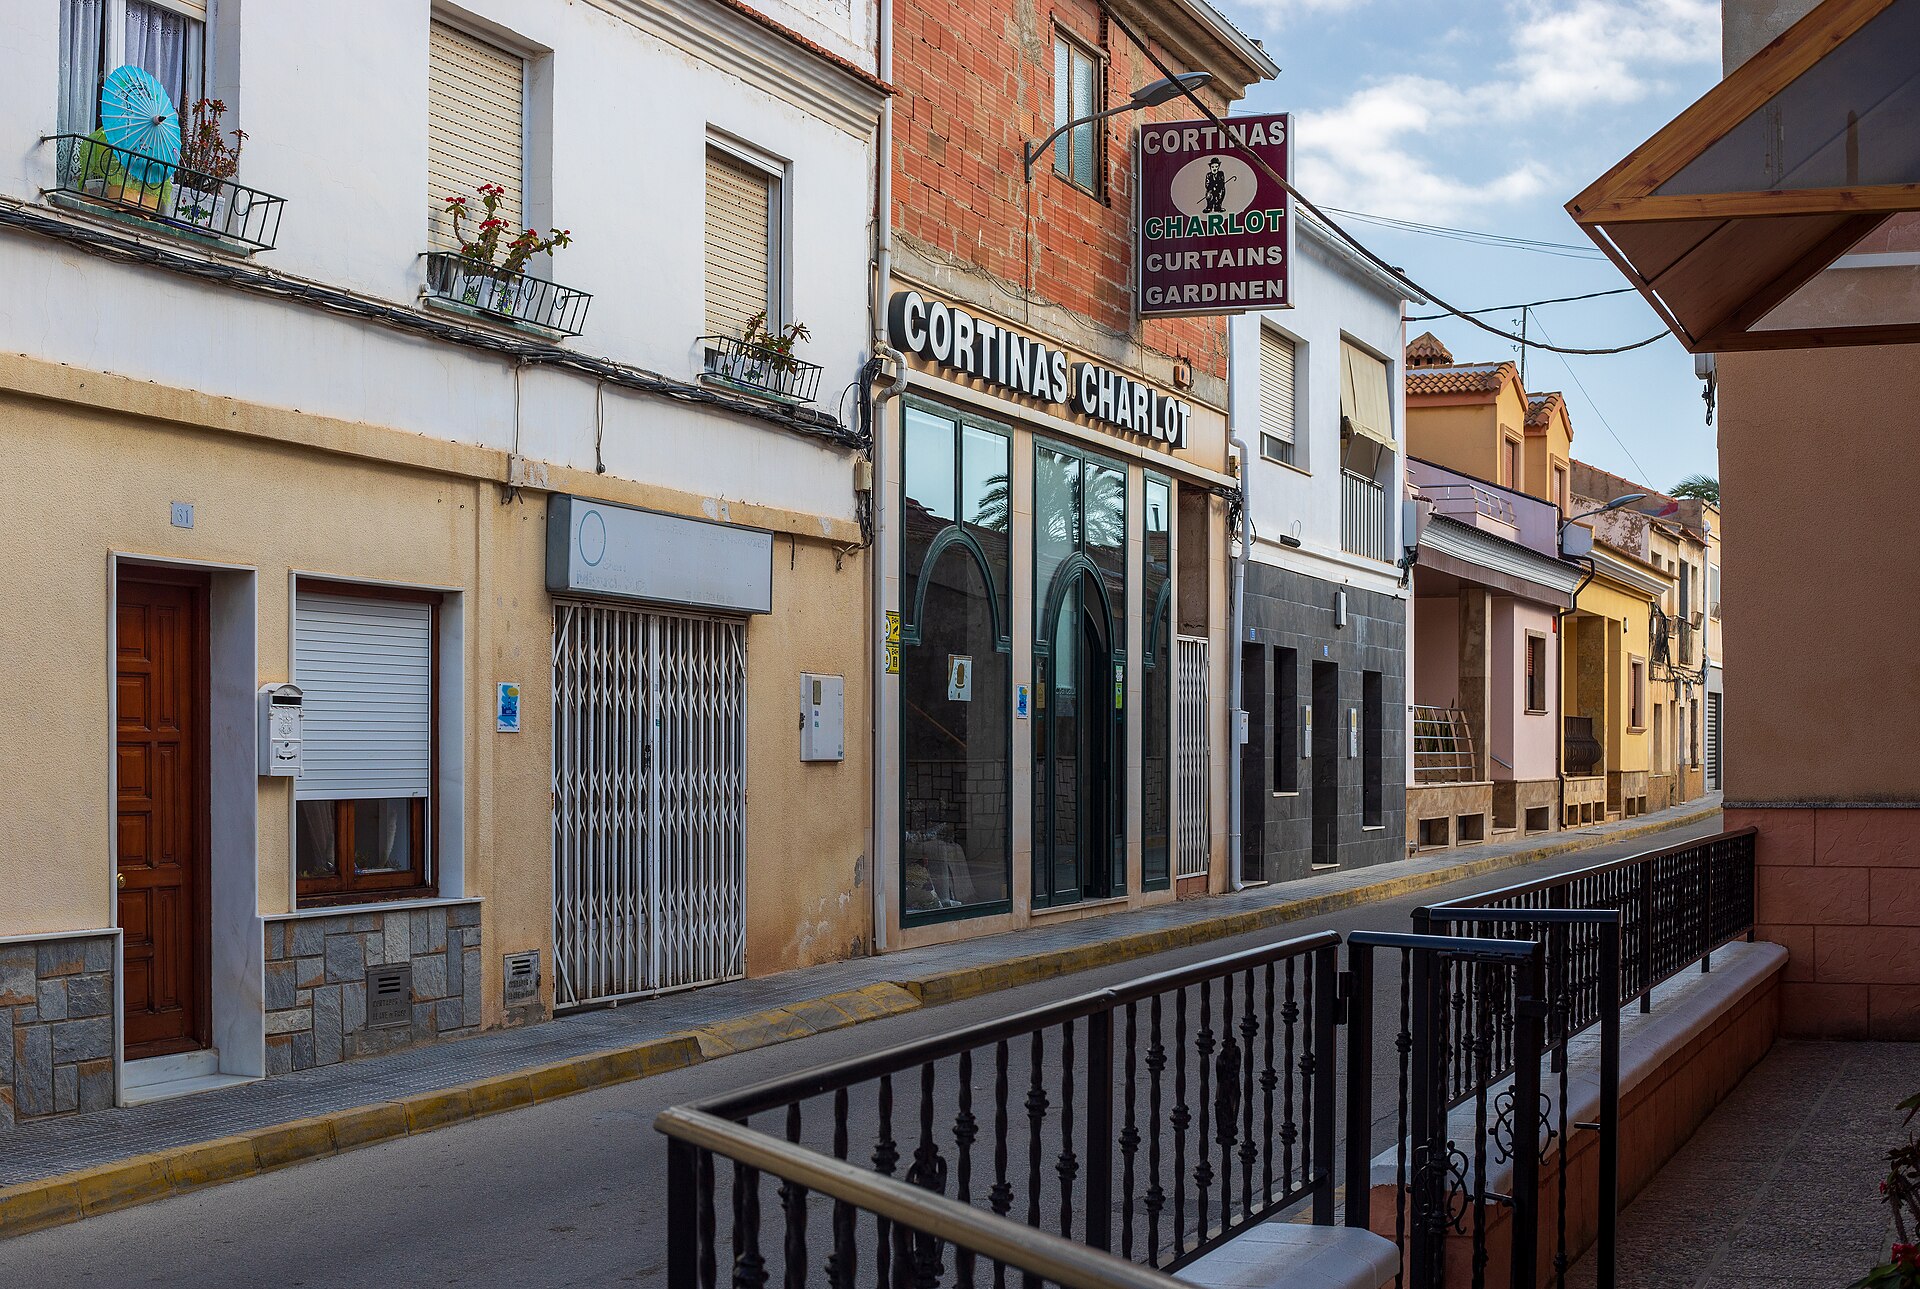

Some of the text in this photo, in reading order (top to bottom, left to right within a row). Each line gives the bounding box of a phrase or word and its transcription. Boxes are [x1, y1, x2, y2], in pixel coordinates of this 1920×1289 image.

[1143, 121, 1286, 155] CORTINAS
[1145, 208, 1285, 240] CHARLOT
[1146, 246, 1283, 273] CURTAINS
[1146, 279, 1284, 305] GARDINEN
[899, 290, 1191, 450] CORTINAS CHARLOT
[176, 506, 189, 524] 31
